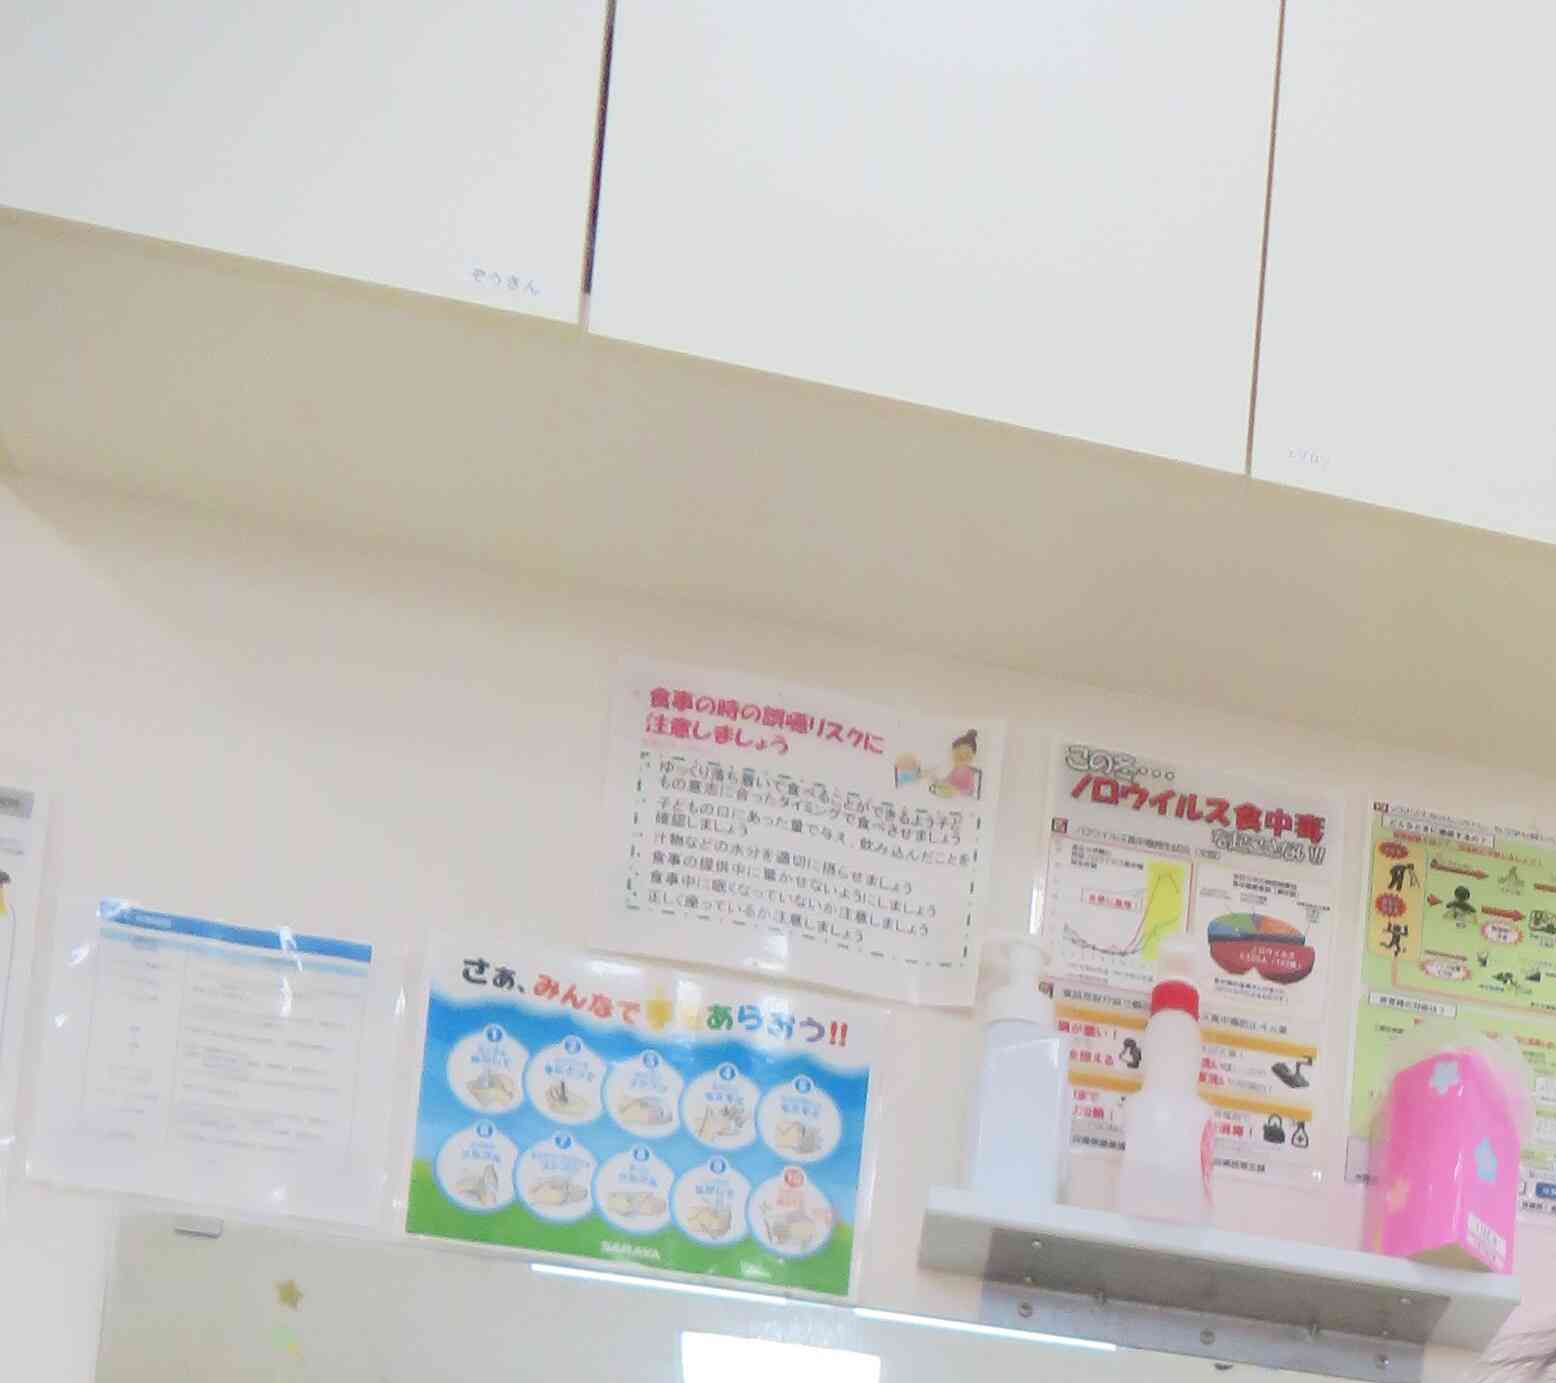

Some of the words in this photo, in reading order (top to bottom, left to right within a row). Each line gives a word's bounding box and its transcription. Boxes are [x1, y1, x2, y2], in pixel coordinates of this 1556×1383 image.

[645, 711, 789, 756] 注意しましょう
[649, 686, 885, 755] 食事の時の誤嚥リスクに
[1070, 773, 1326, 845] ノロウイルス食中毒
